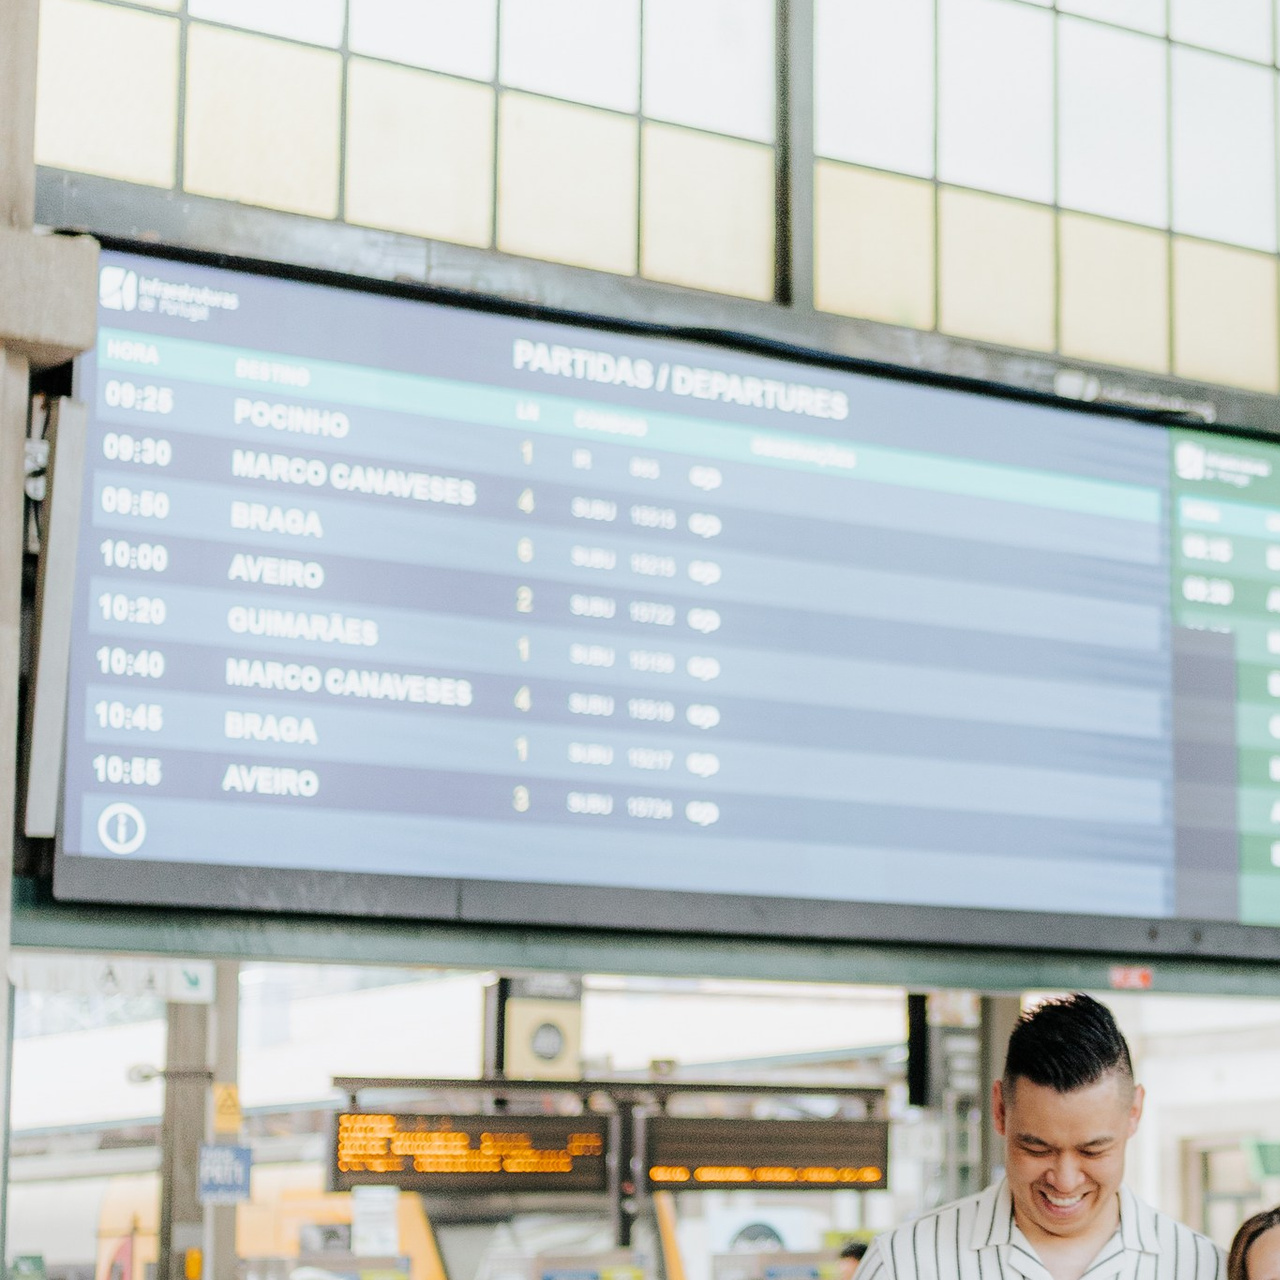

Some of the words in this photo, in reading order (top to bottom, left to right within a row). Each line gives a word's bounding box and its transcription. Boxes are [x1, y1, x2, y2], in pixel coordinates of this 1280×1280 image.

[107, 339, 159, 365] HORA
[235, 357, 311, 388] DESTINO
[513, 338, 654, 389] PARTIDAS
[671, 364, 849, 420] DEPARTURES
[105, 380, 174, 414] 09:25
[234, 397, 350, 438] POCINHO
[520, 439, 533, 465] 1
[103, 432, 172, 466] 09:30
[232, 449, 327, 487] MARCO
[330, 463, 477, 507] CANAVESES
[518, 488, 534, 513] 4
[101, 486, 170, 519] 09:50
[231, 501, 323, 538] BRAGA
[100, 539, 168, 572] 10:00
[228, 553, 324, 589] AVEIRO
[517, 586, 533, 612] 2
[99, 592, 166, 625] 10:20
[227, 606, 379, 647] GUIMARÃES
[517, 635, 530, 662] 1
[96, 646, 165, 678] 10:40
[225, 657, 322, 692] MARCO
[325, 668, 472, 706] CANAVESES
[514, 685, 531, 712] 4
[95, 700, 163, 732] 10:45
[224, 710, 318, 745] BRAGA
[514, 734, 529, 762] 1
[93, 754, 162, 786] 10:55
[222, 764, 319, 797] AVEIRO
